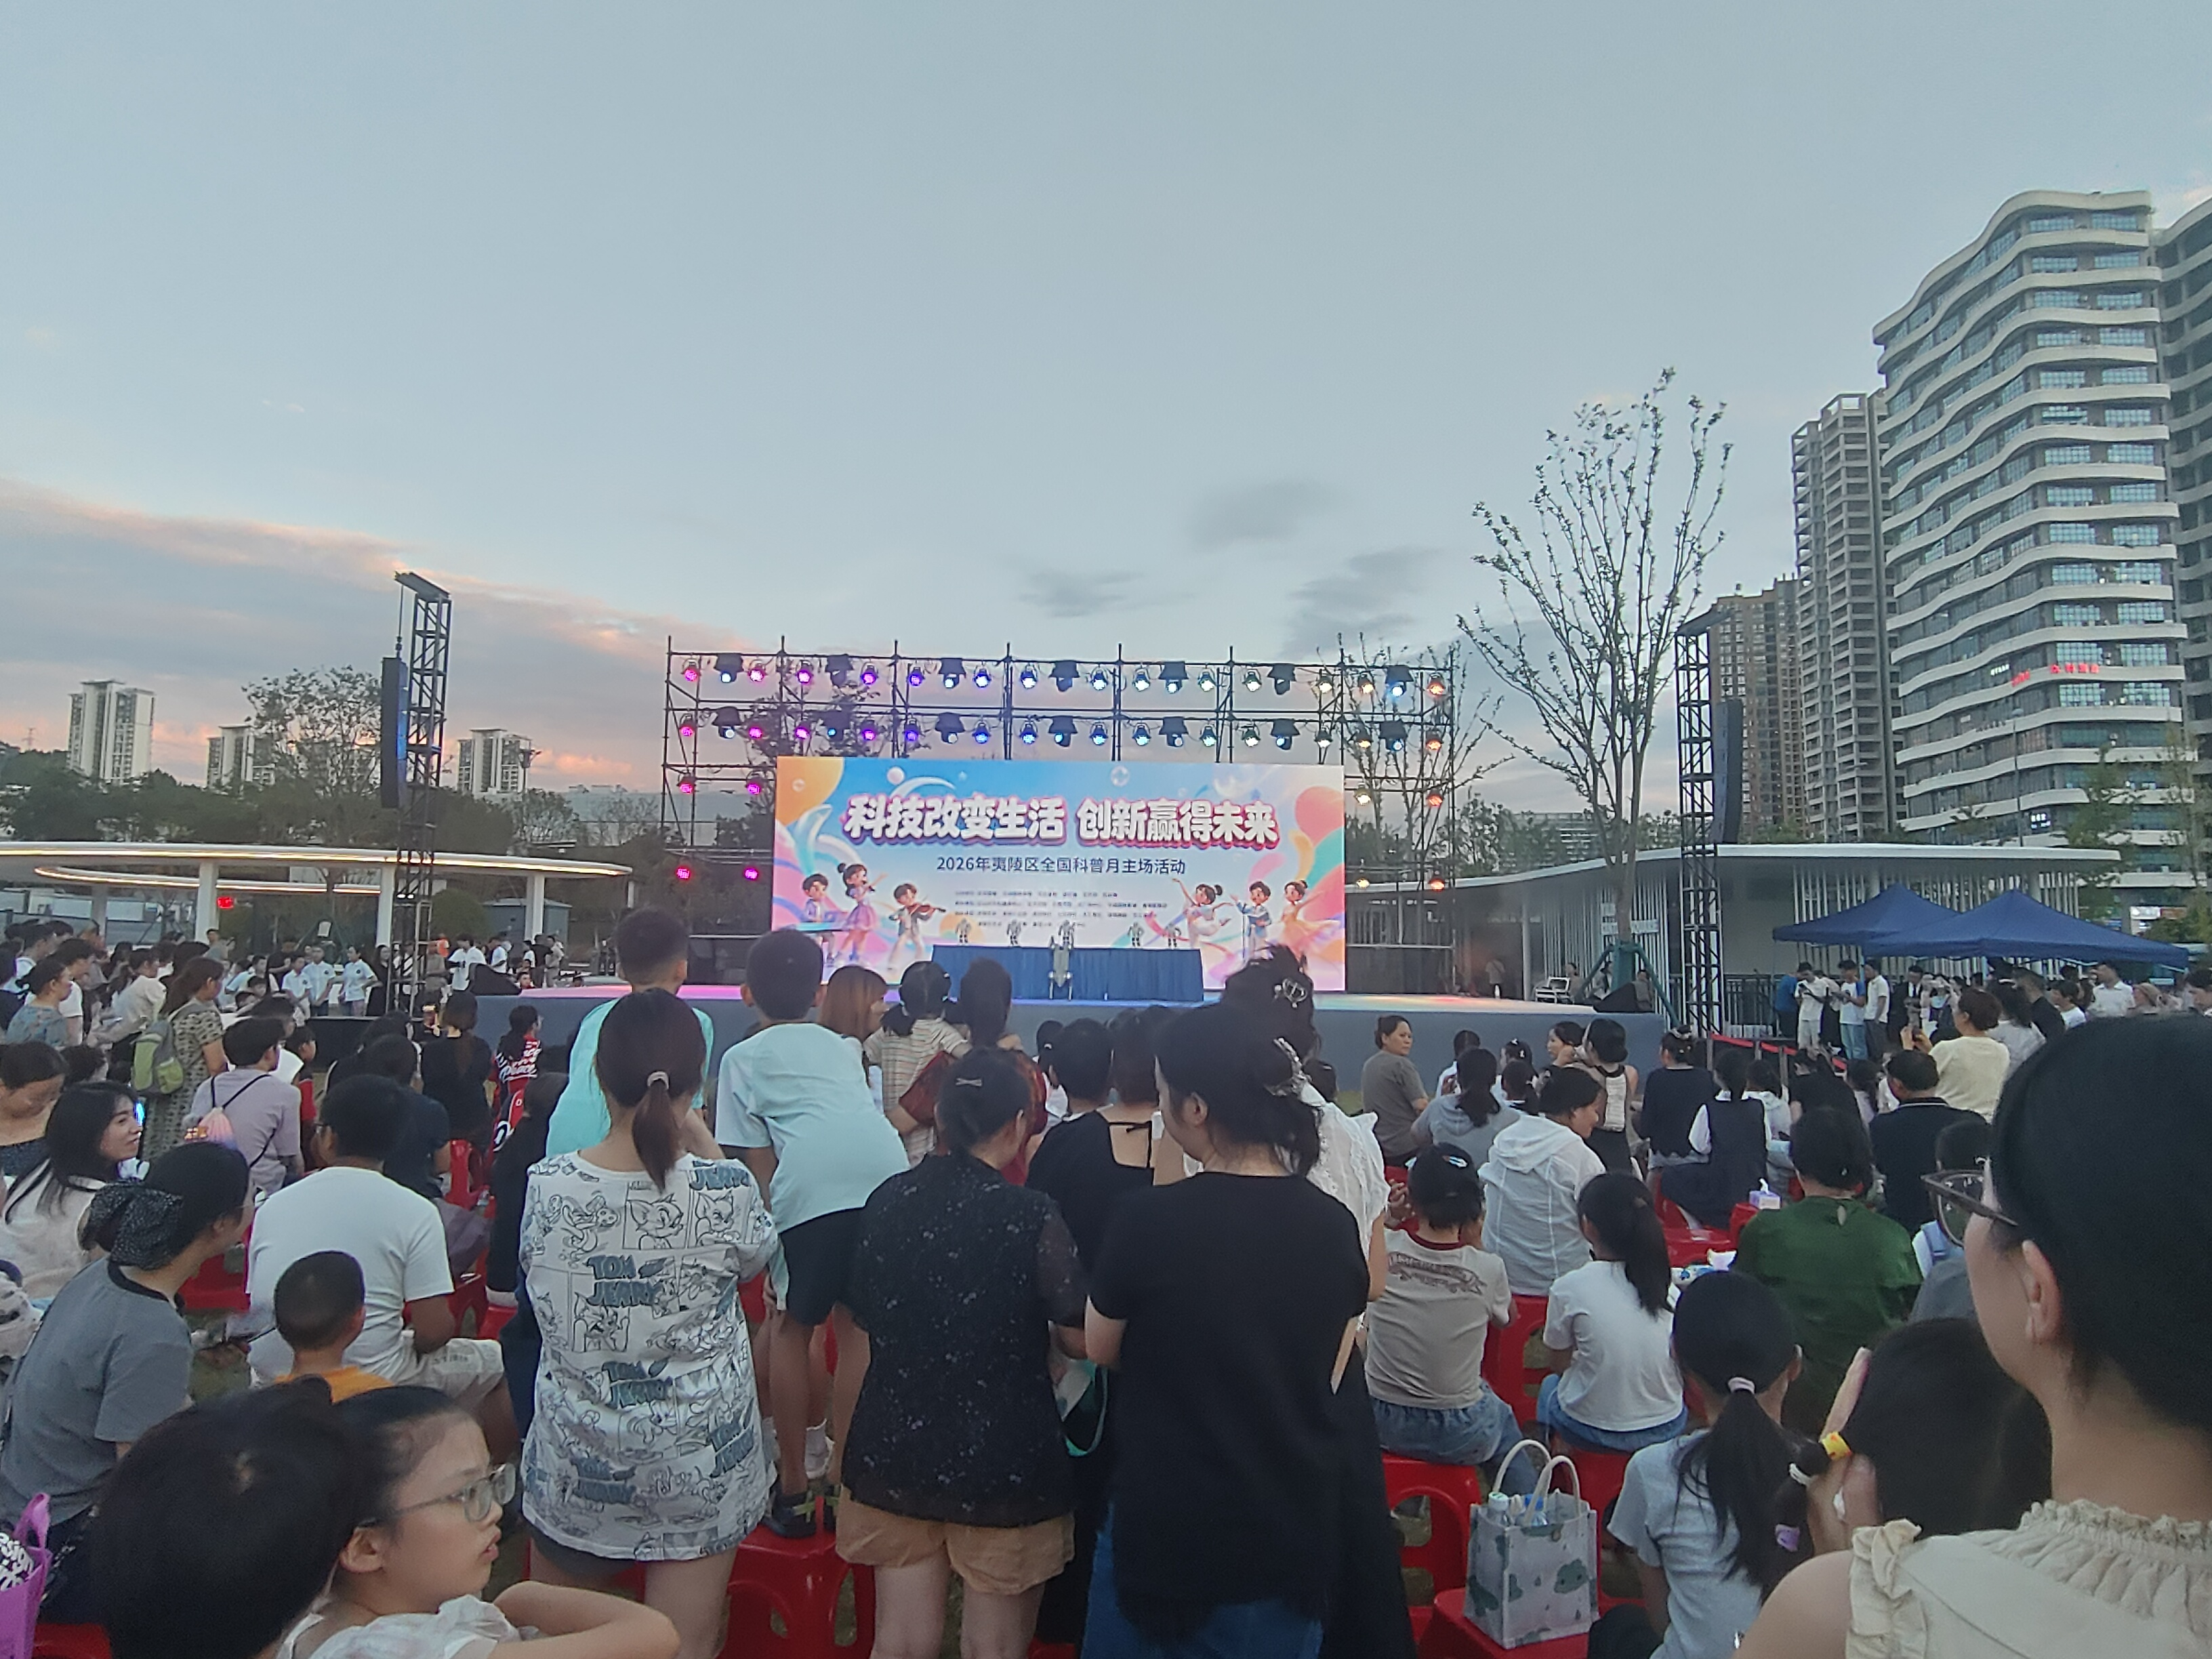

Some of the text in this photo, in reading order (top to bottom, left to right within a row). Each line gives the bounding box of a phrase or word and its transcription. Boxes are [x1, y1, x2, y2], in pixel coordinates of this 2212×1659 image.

[844, 794, 1278, 844] 科技改变生活 创新赢得未来
[936, 856, 1186, 875] 2026年夷陵区全国科普月主场活动
[583, 1254, 636, 1279] TOM
[586, 1280, 664, 1308] JERRY
